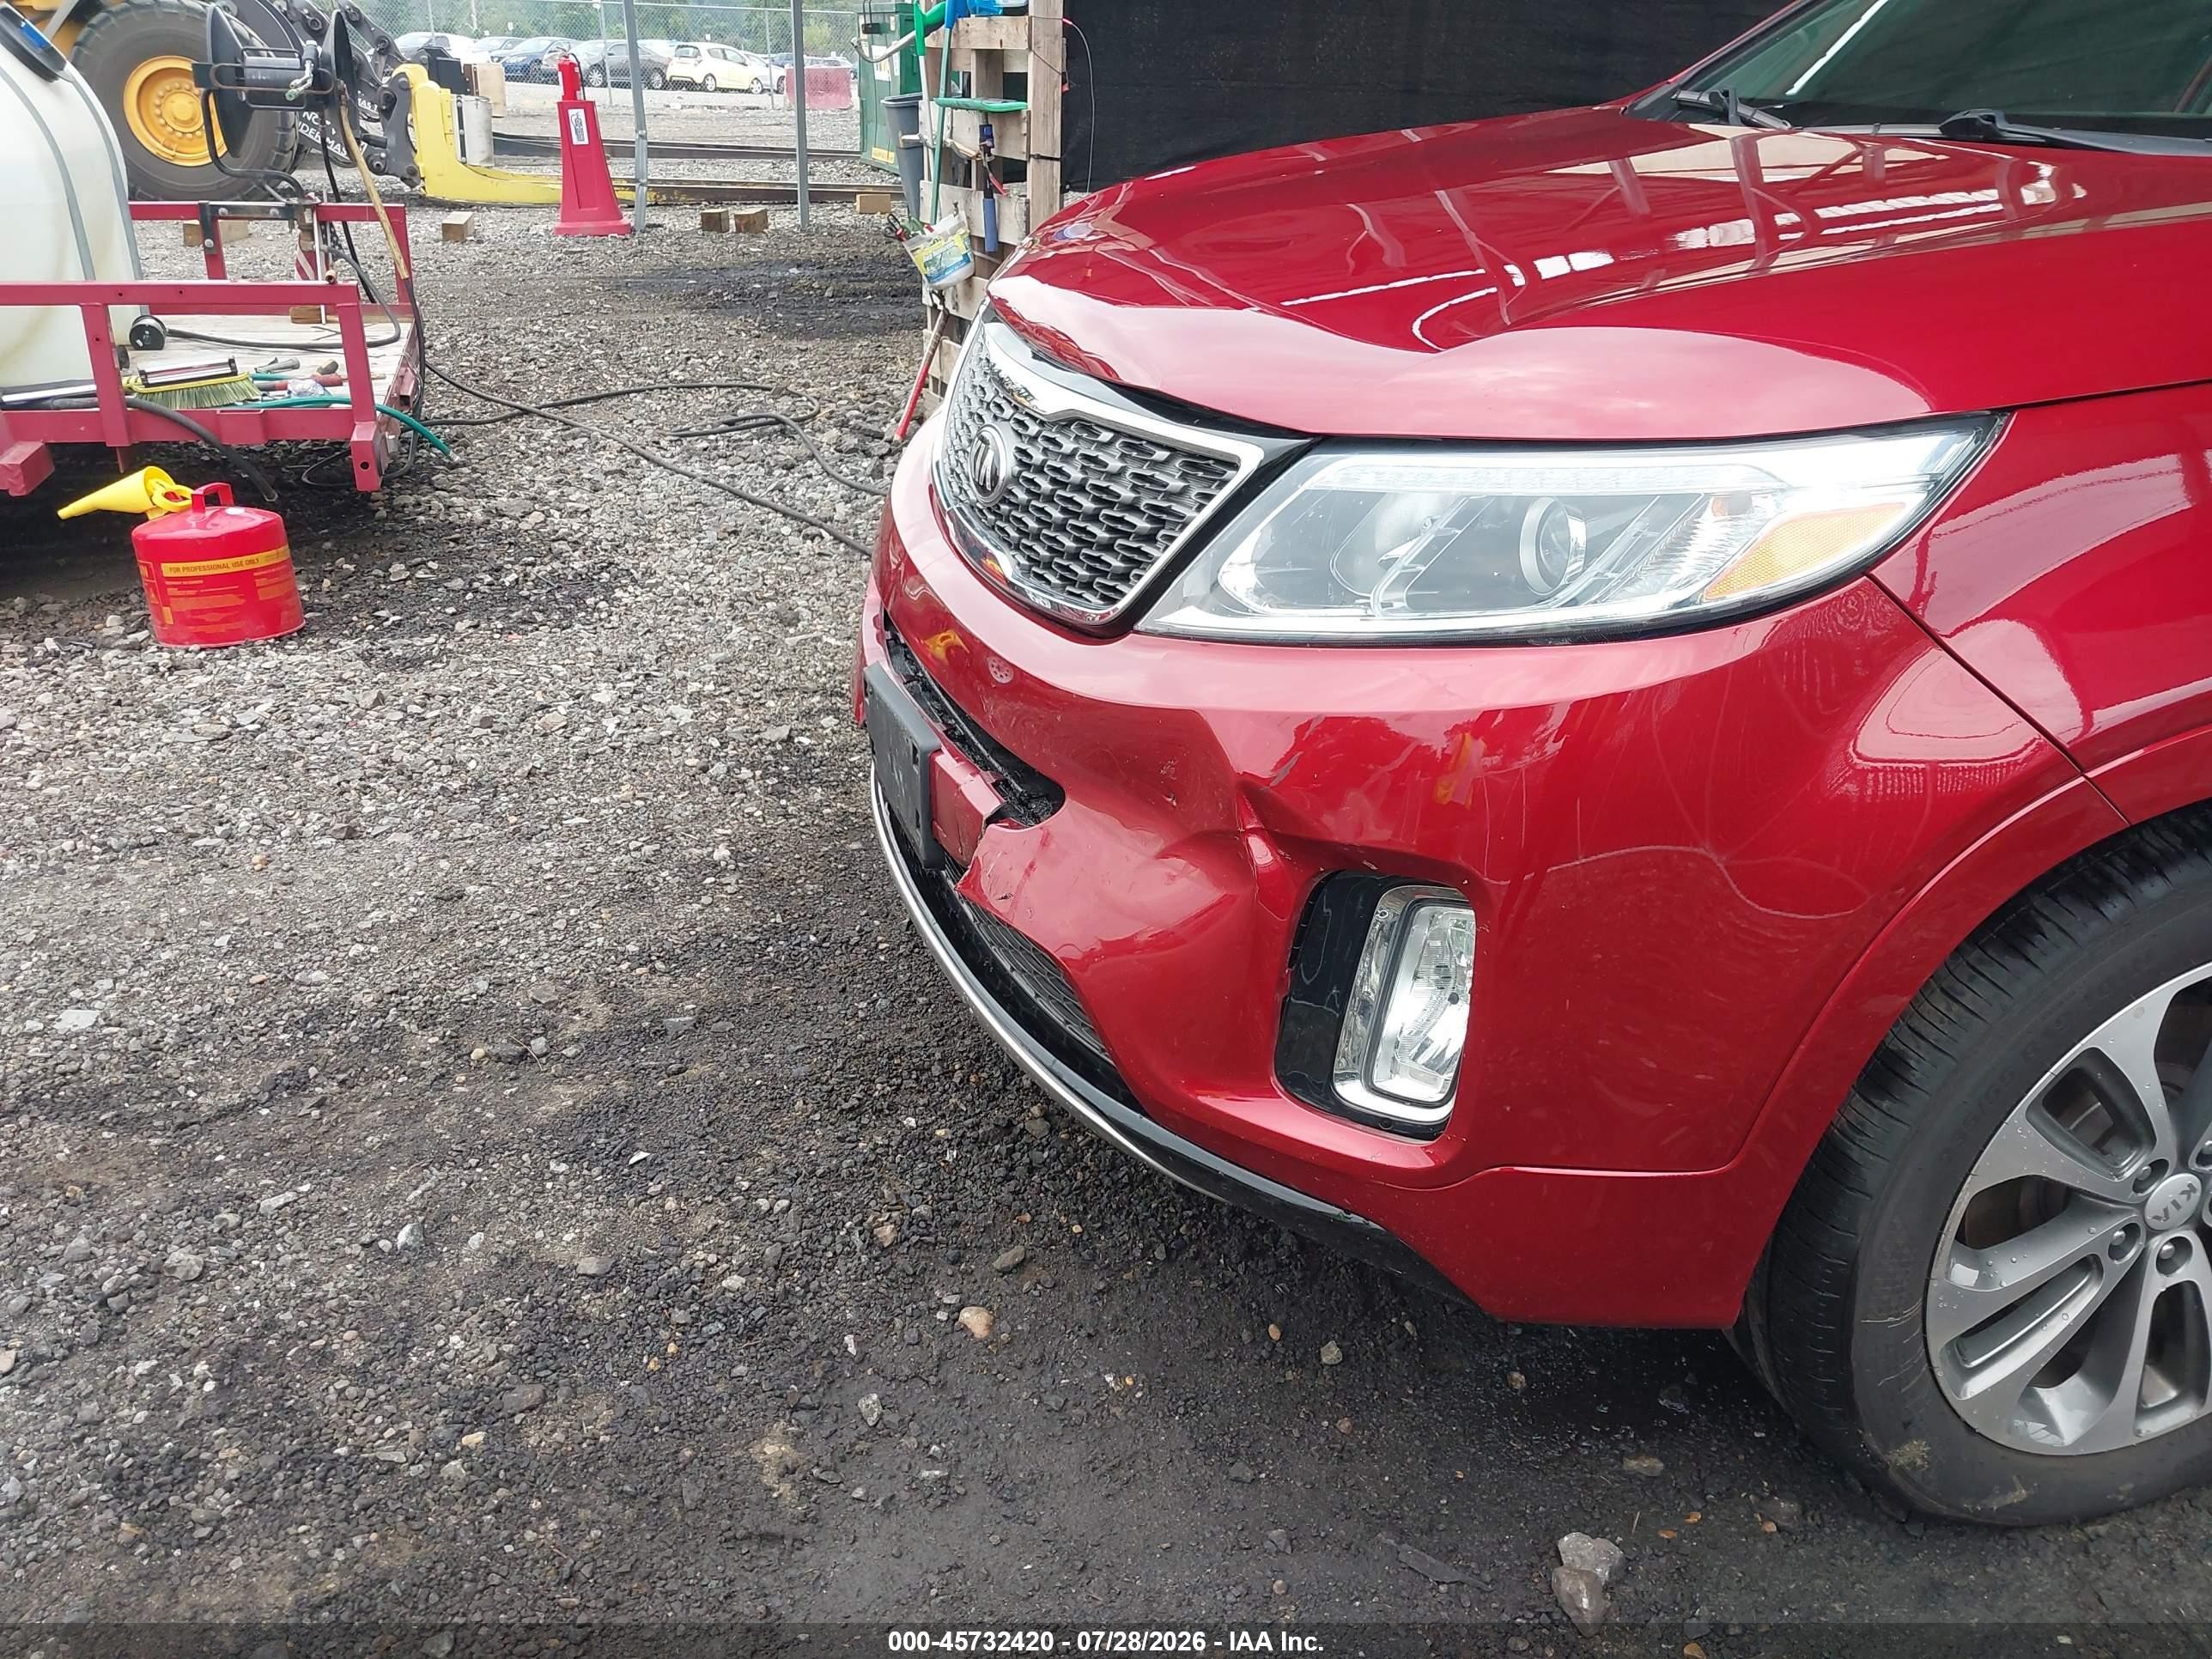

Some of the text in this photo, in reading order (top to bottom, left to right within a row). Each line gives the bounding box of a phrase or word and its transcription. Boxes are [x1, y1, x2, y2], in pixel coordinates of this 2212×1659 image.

[182, 563, 229, 573] PROFESSIONAL
[246, 557, 259, 566] ONLY
[2152, 1182, 2197, 1223] KIA
